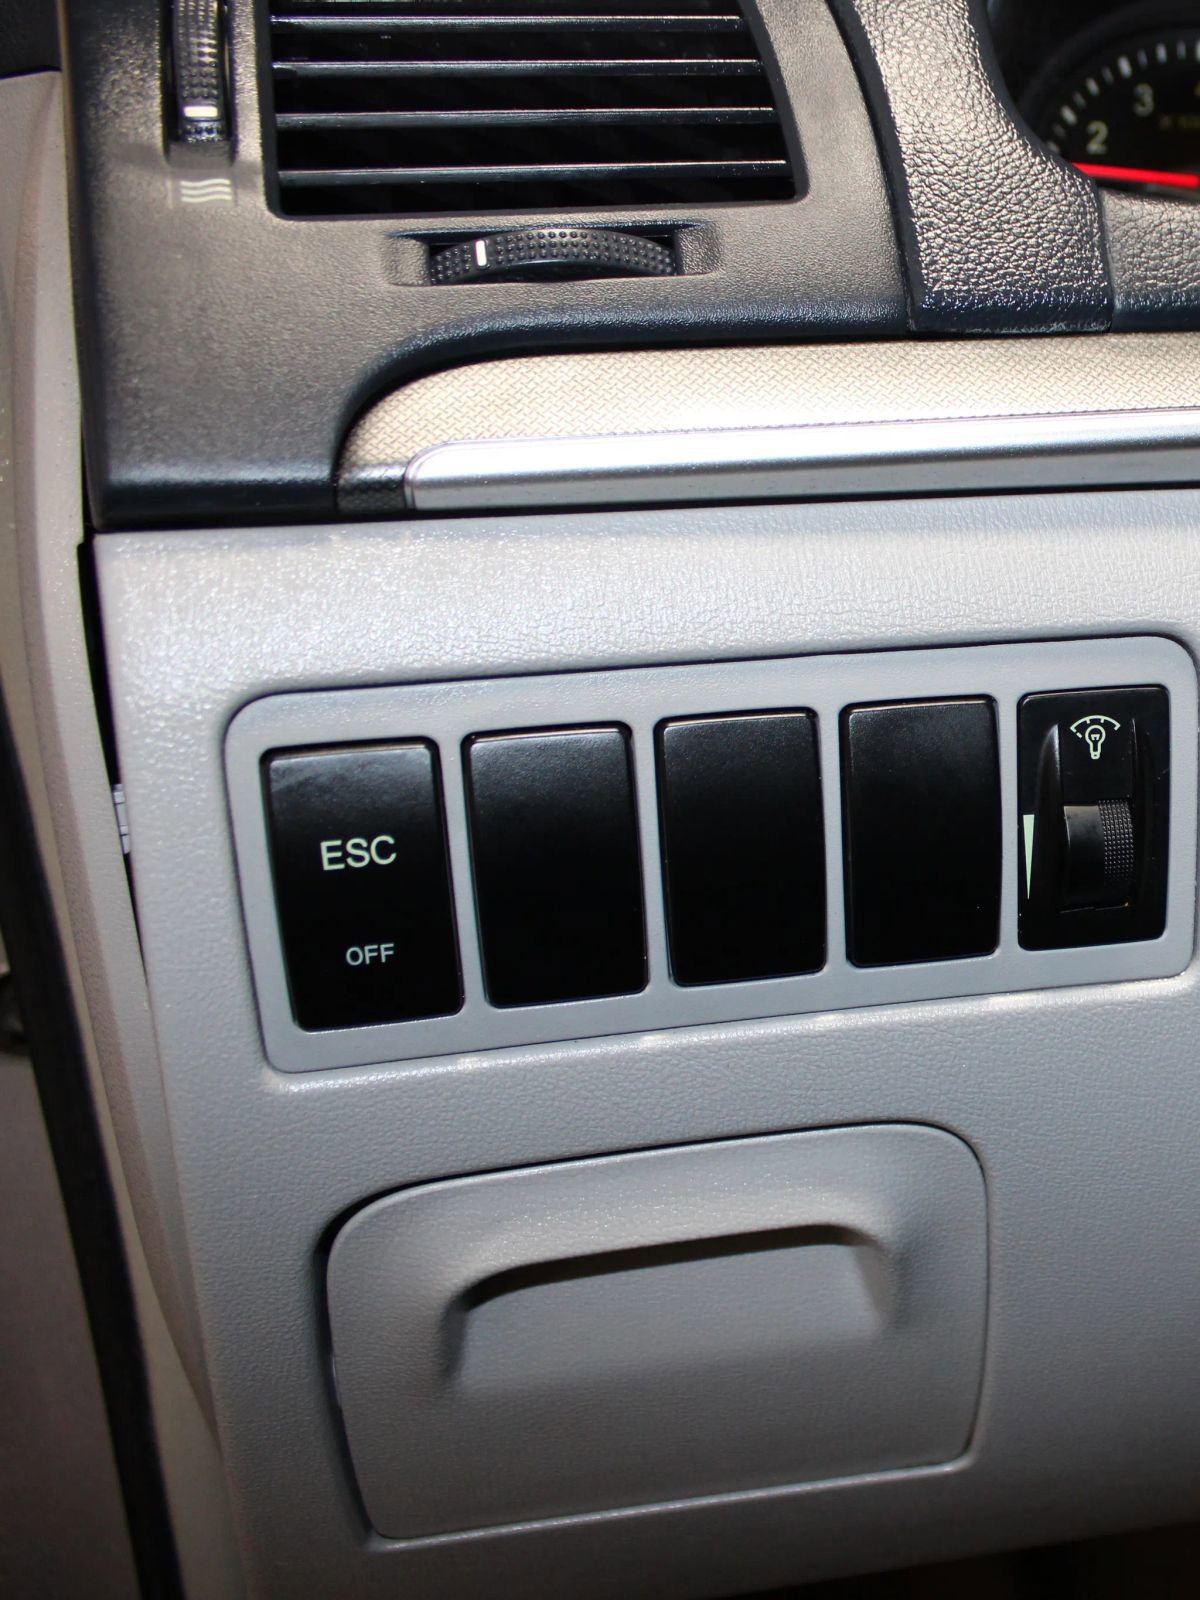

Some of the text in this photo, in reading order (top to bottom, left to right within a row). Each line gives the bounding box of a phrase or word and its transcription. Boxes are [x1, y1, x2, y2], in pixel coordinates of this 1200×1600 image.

[1132, 83, 1155, 118] 3
[1086, 120, 1109, 155] 2
[320, 834, 397, 871] ESC
[345, 942, 395, 966] OFF
